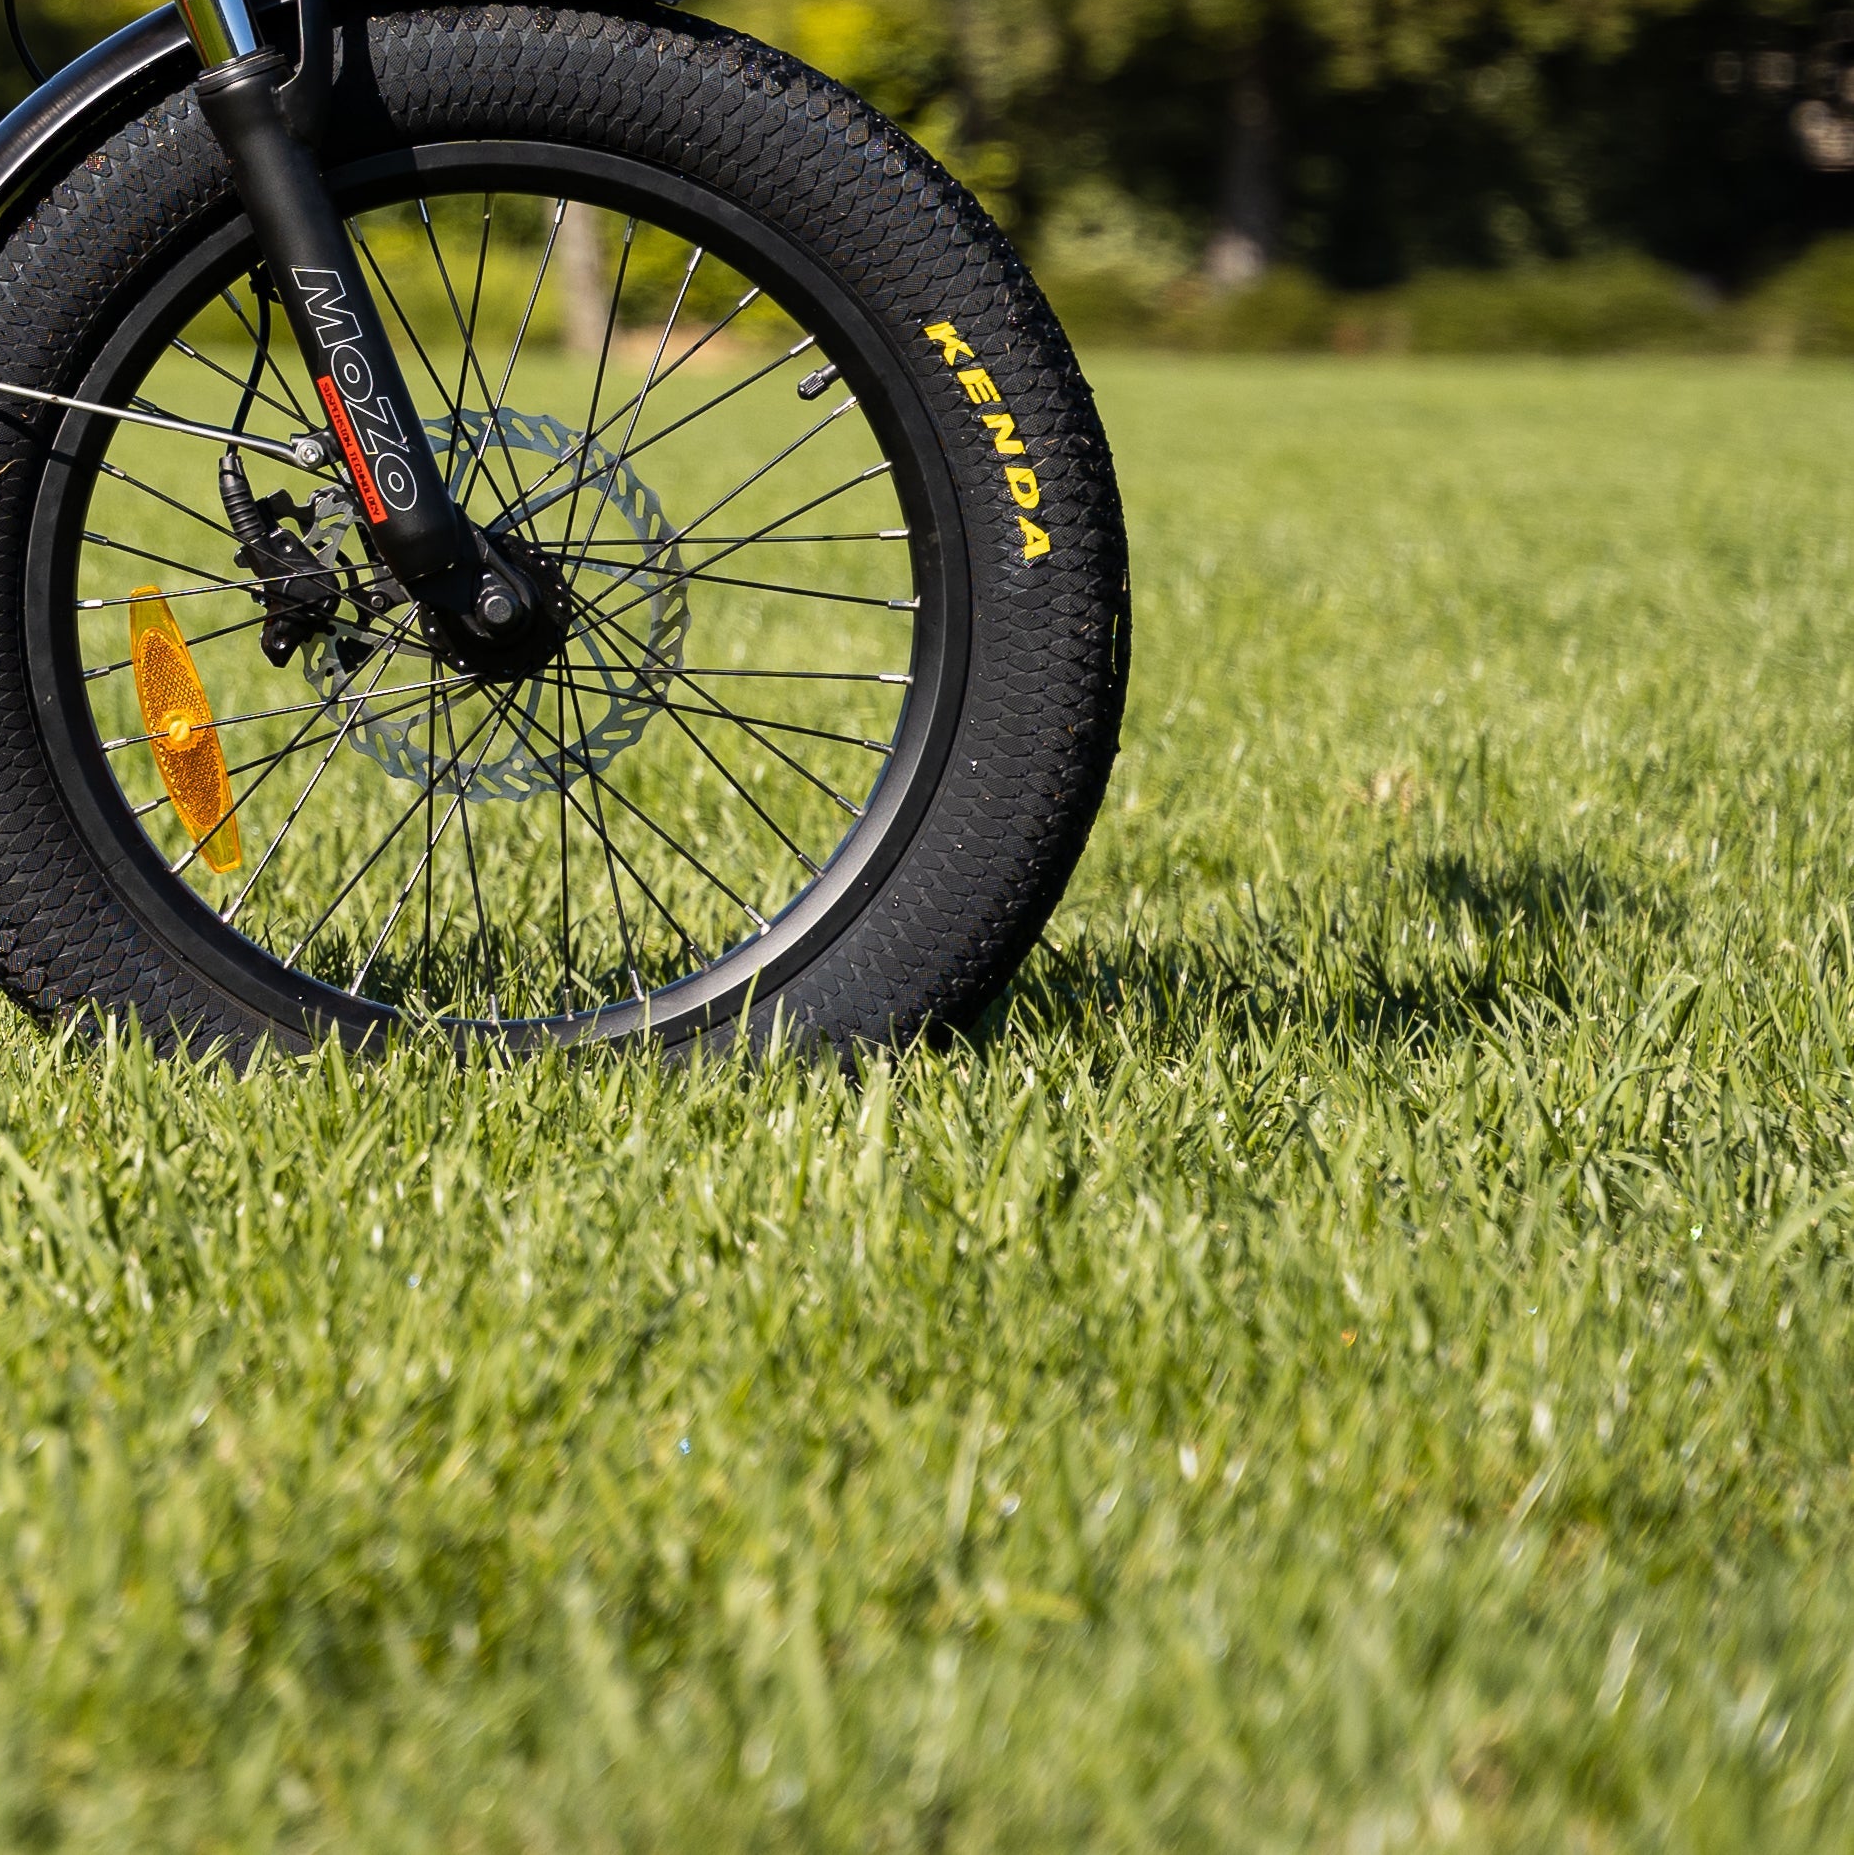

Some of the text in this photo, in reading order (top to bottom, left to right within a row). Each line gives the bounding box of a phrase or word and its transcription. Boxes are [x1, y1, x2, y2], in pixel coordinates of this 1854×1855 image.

[291, 268, 417, 511] MOZO
[322, 382, 381, 517] SUSPENSION TECHNOLOGY
[924, 321, 1051, 560] KENDA
